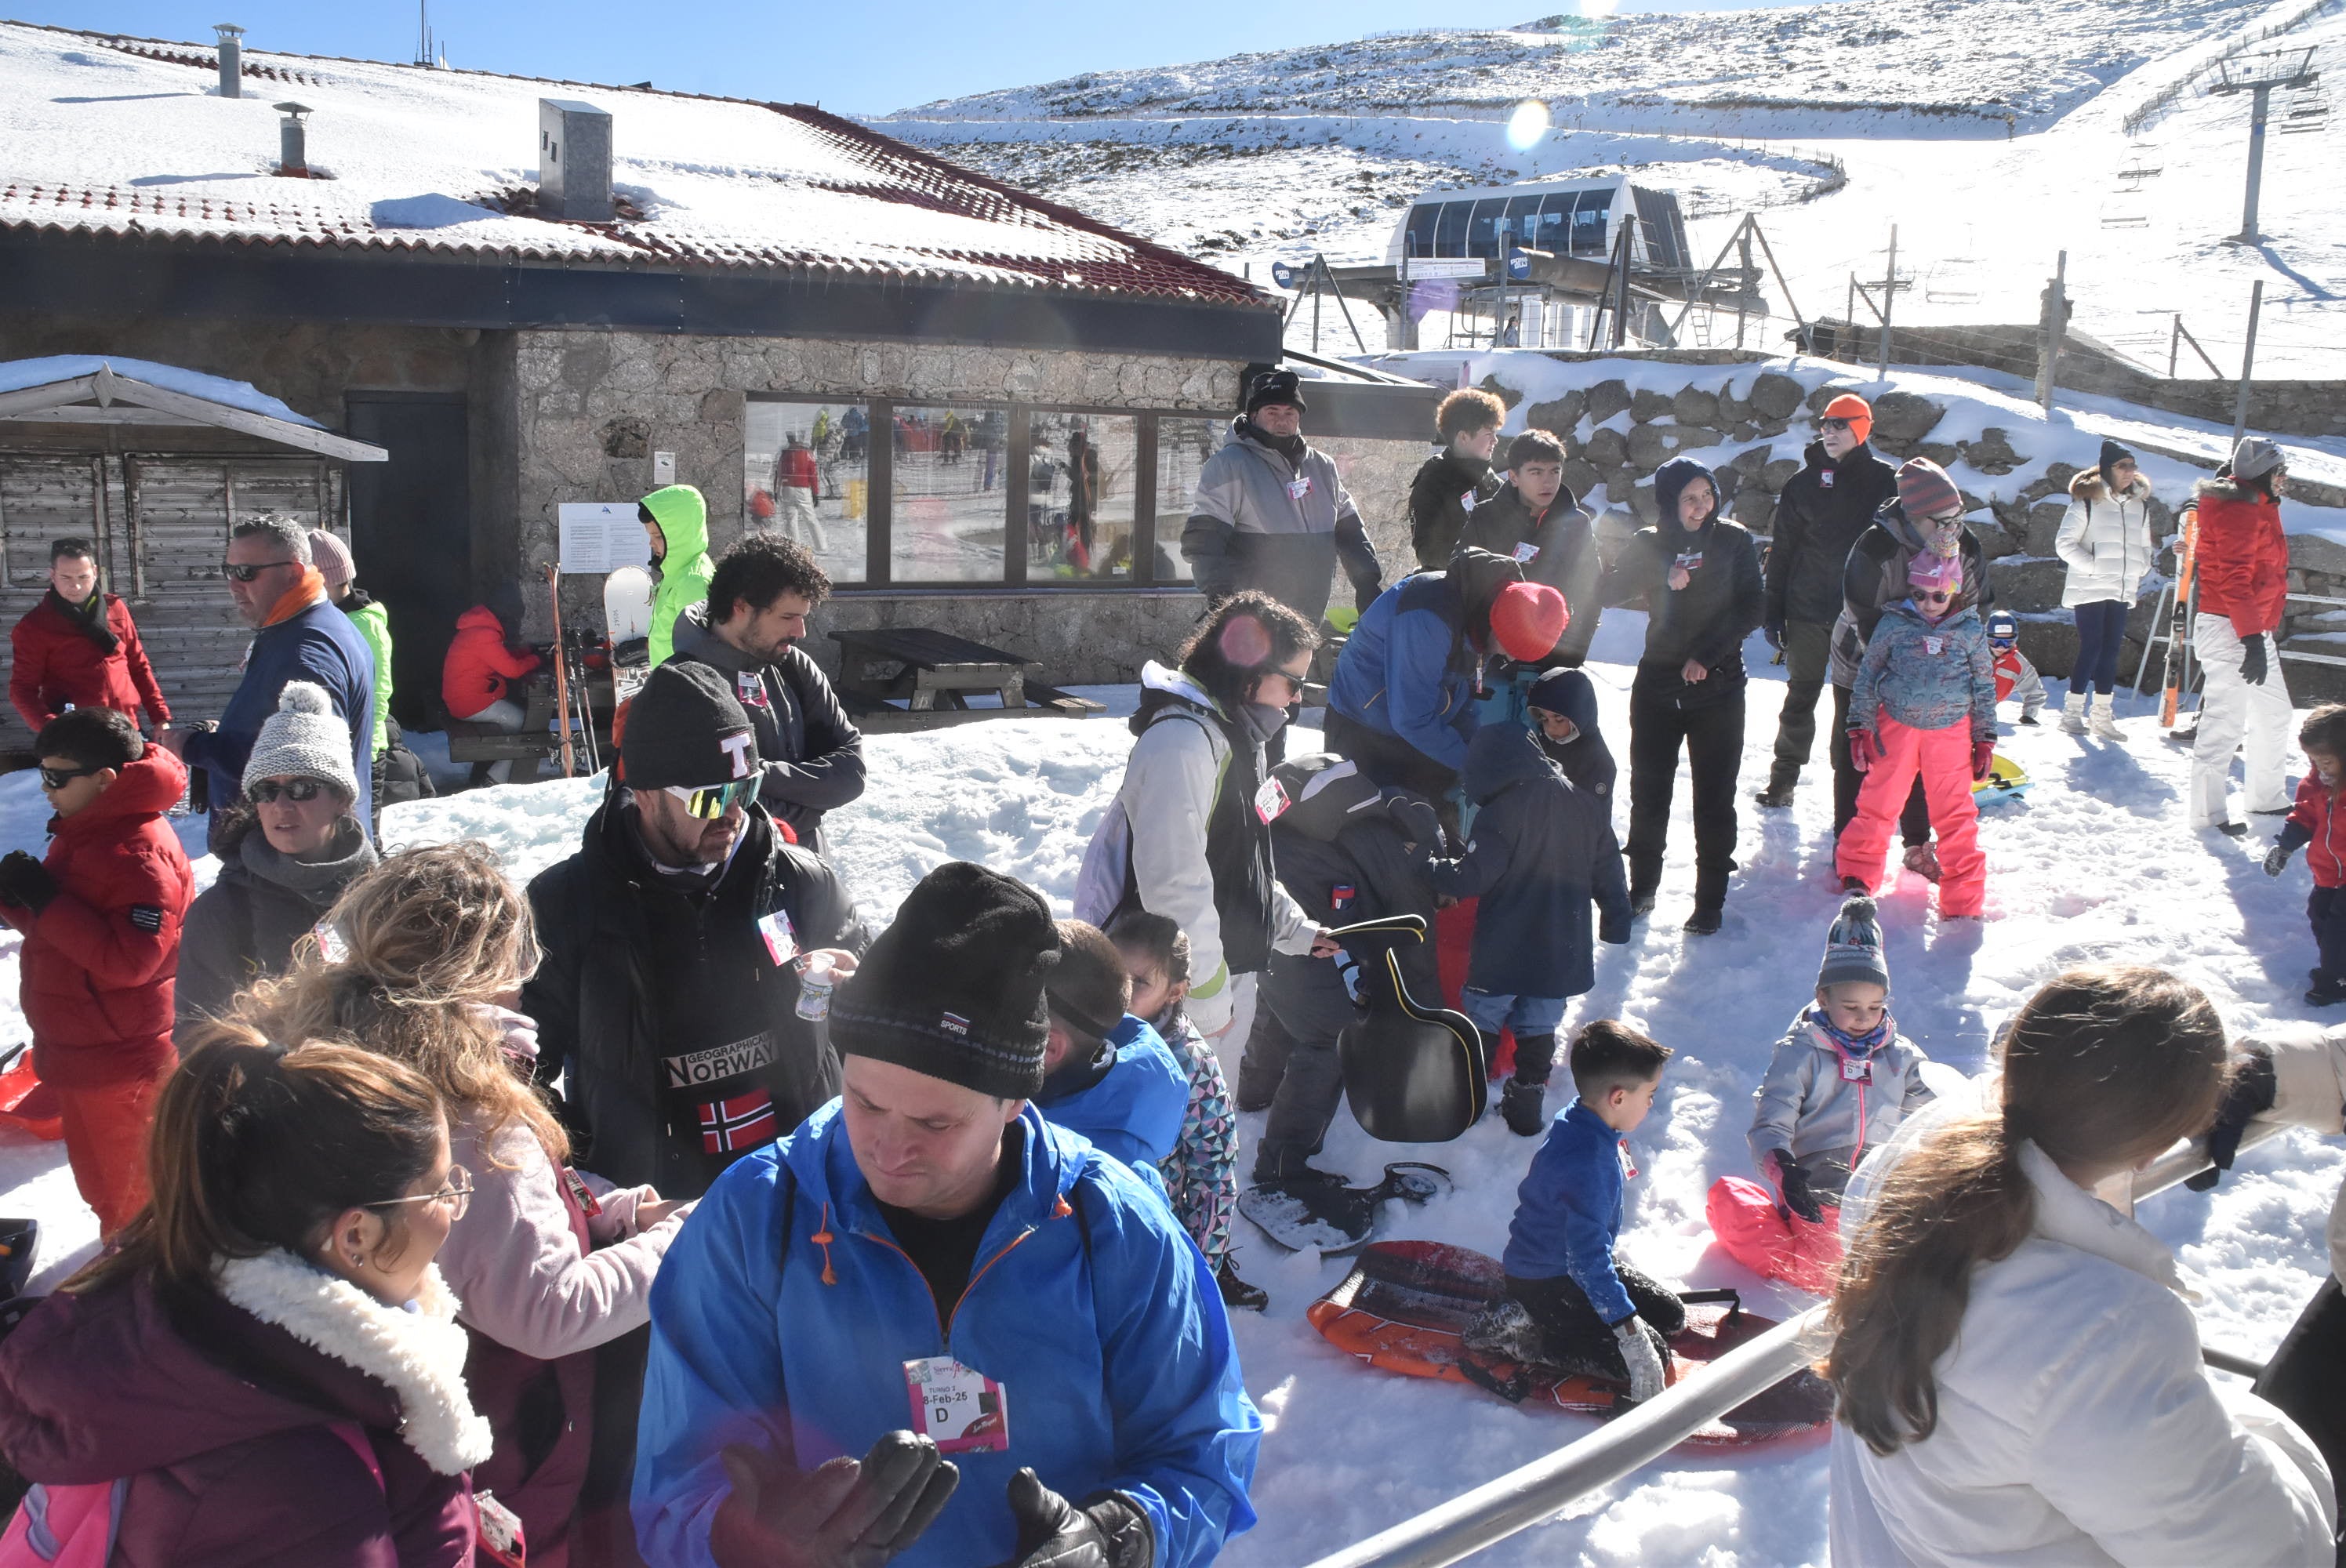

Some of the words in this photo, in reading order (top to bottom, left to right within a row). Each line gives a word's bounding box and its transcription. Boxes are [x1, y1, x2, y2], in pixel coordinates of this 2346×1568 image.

[719, 731, 752, 779] T
[940, 1019, 968, 1036] SPORTS
[935, 1407, 949, 1424] D
